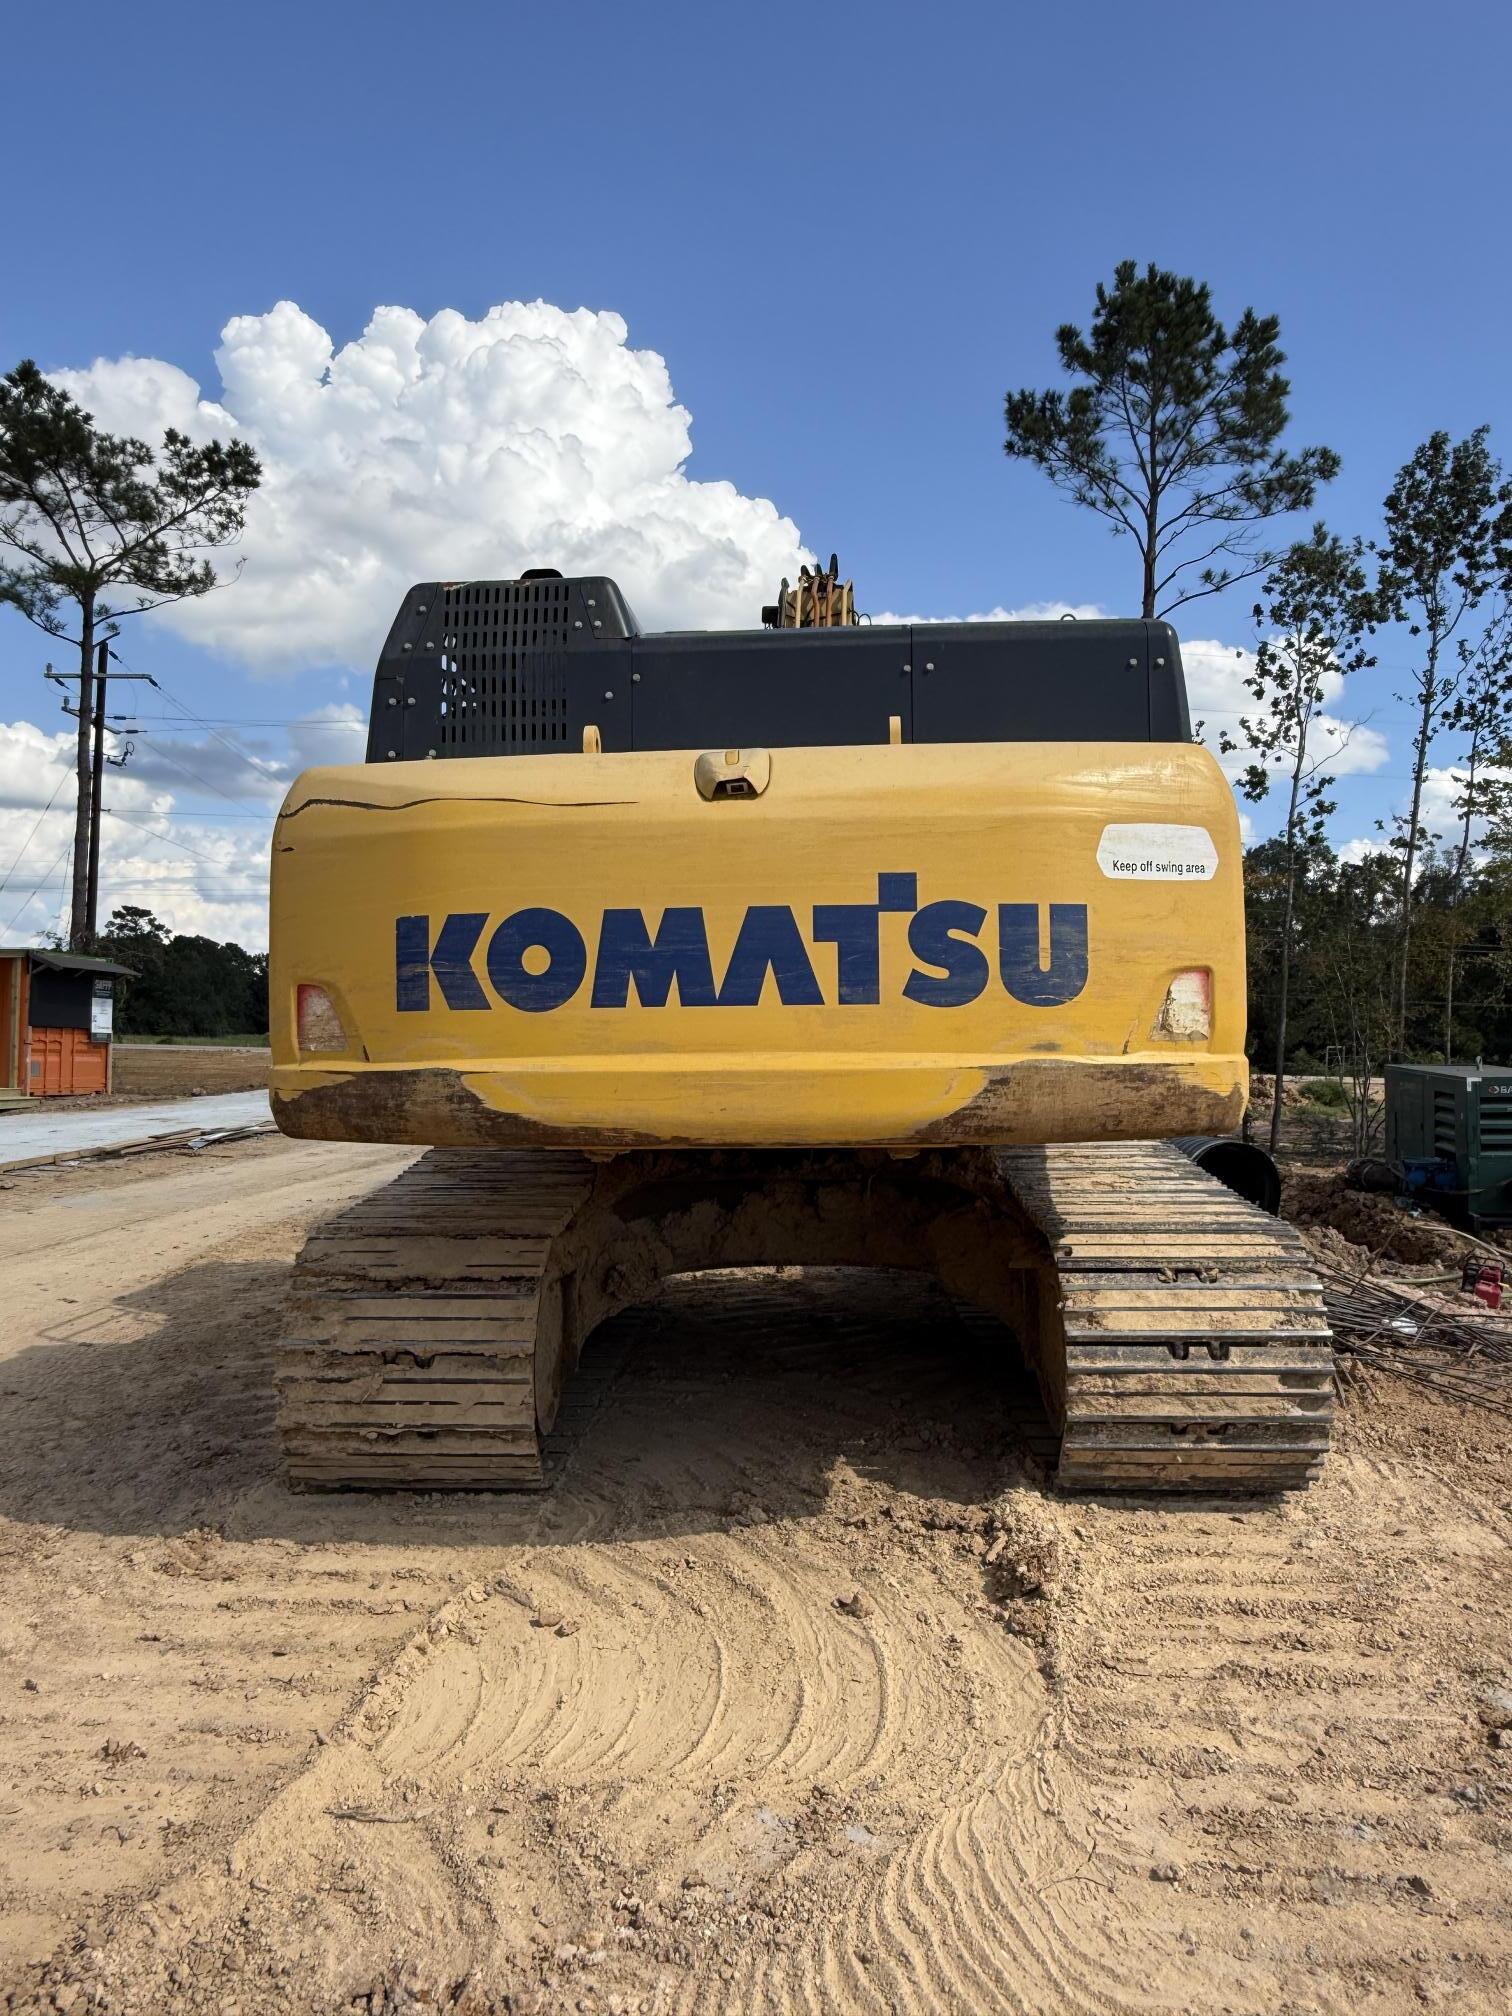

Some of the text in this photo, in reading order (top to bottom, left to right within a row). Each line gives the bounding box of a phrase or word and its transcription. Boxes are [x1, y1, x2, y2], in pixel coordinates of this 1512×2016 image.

[1112, 859, 1206, 876] Keep off swing area
[395, 871, 1089, 1012] KOMATSU
